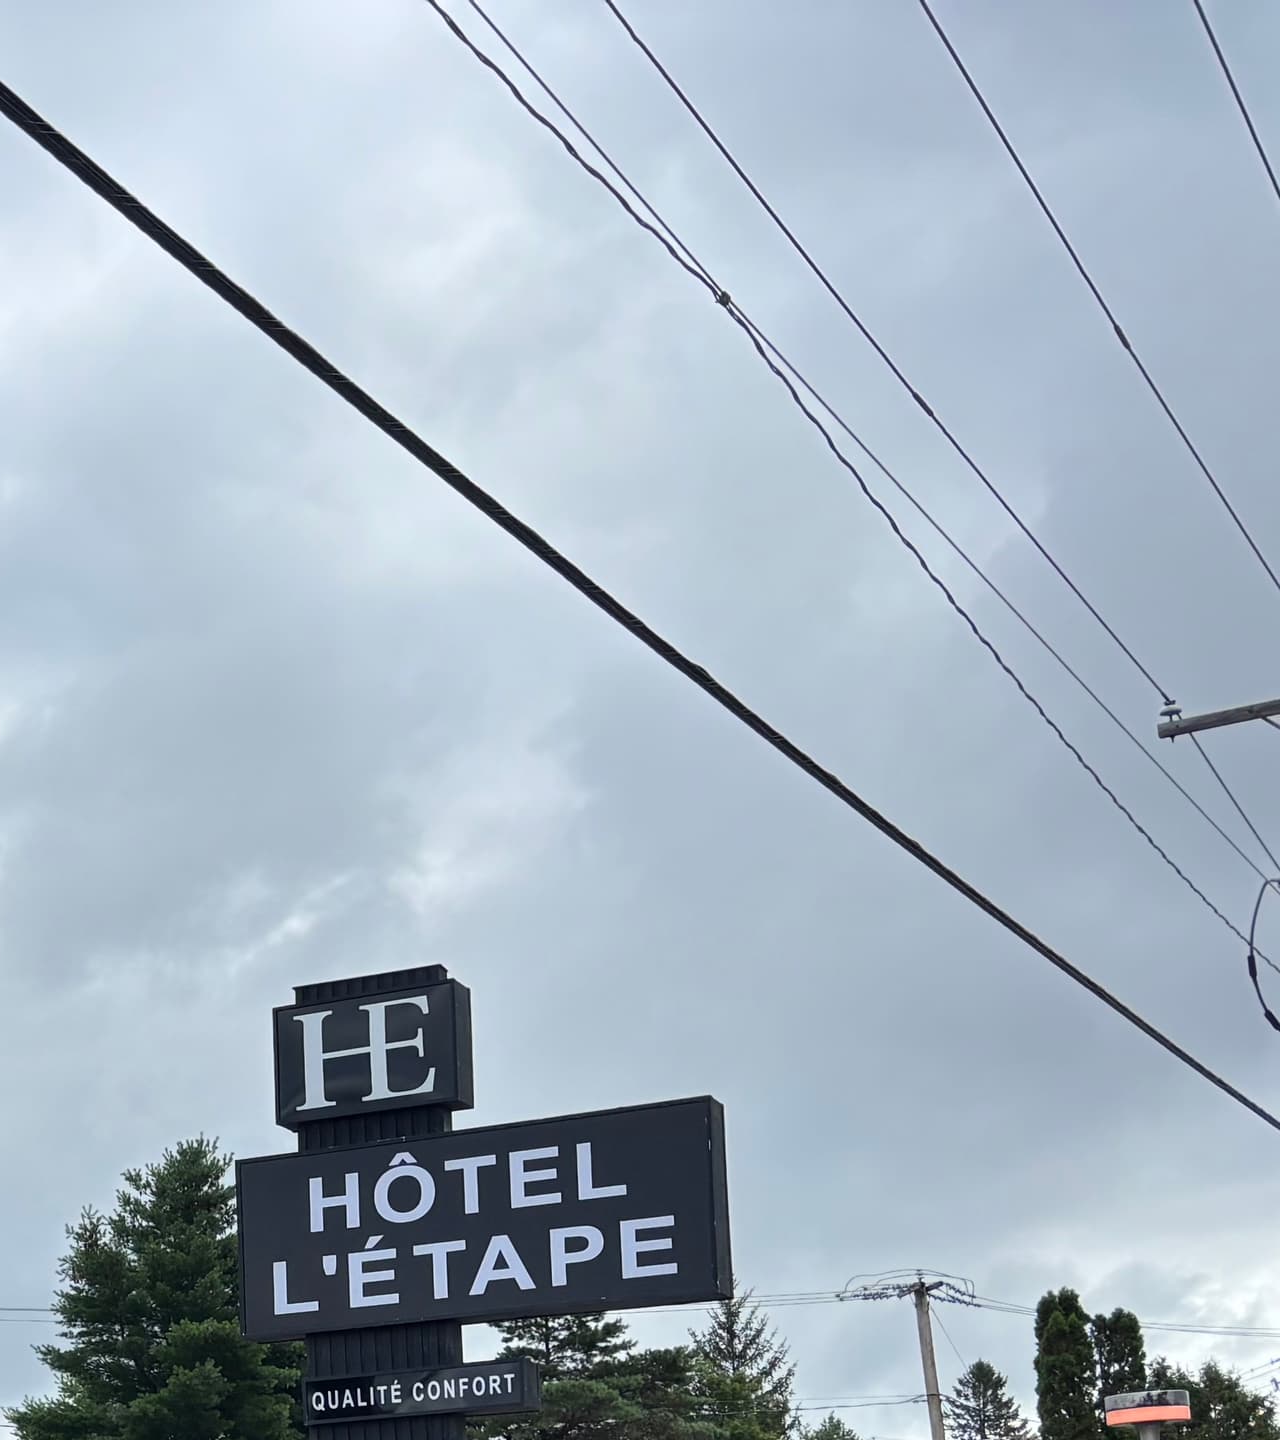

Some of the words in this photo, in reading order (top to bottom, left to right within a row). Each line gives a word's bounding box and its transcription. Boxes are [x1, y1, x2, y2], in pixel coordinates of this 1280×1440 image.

[292, 994, 437, 1112] HE
[308, 1141, 628, 1233] HÔTEL
[272, 1214, 679, 1316] L'ÉTAPE
[311, 1379, 403, 1412] QUALITÉ
[412, 1373, 516, 1402] CONFORT
